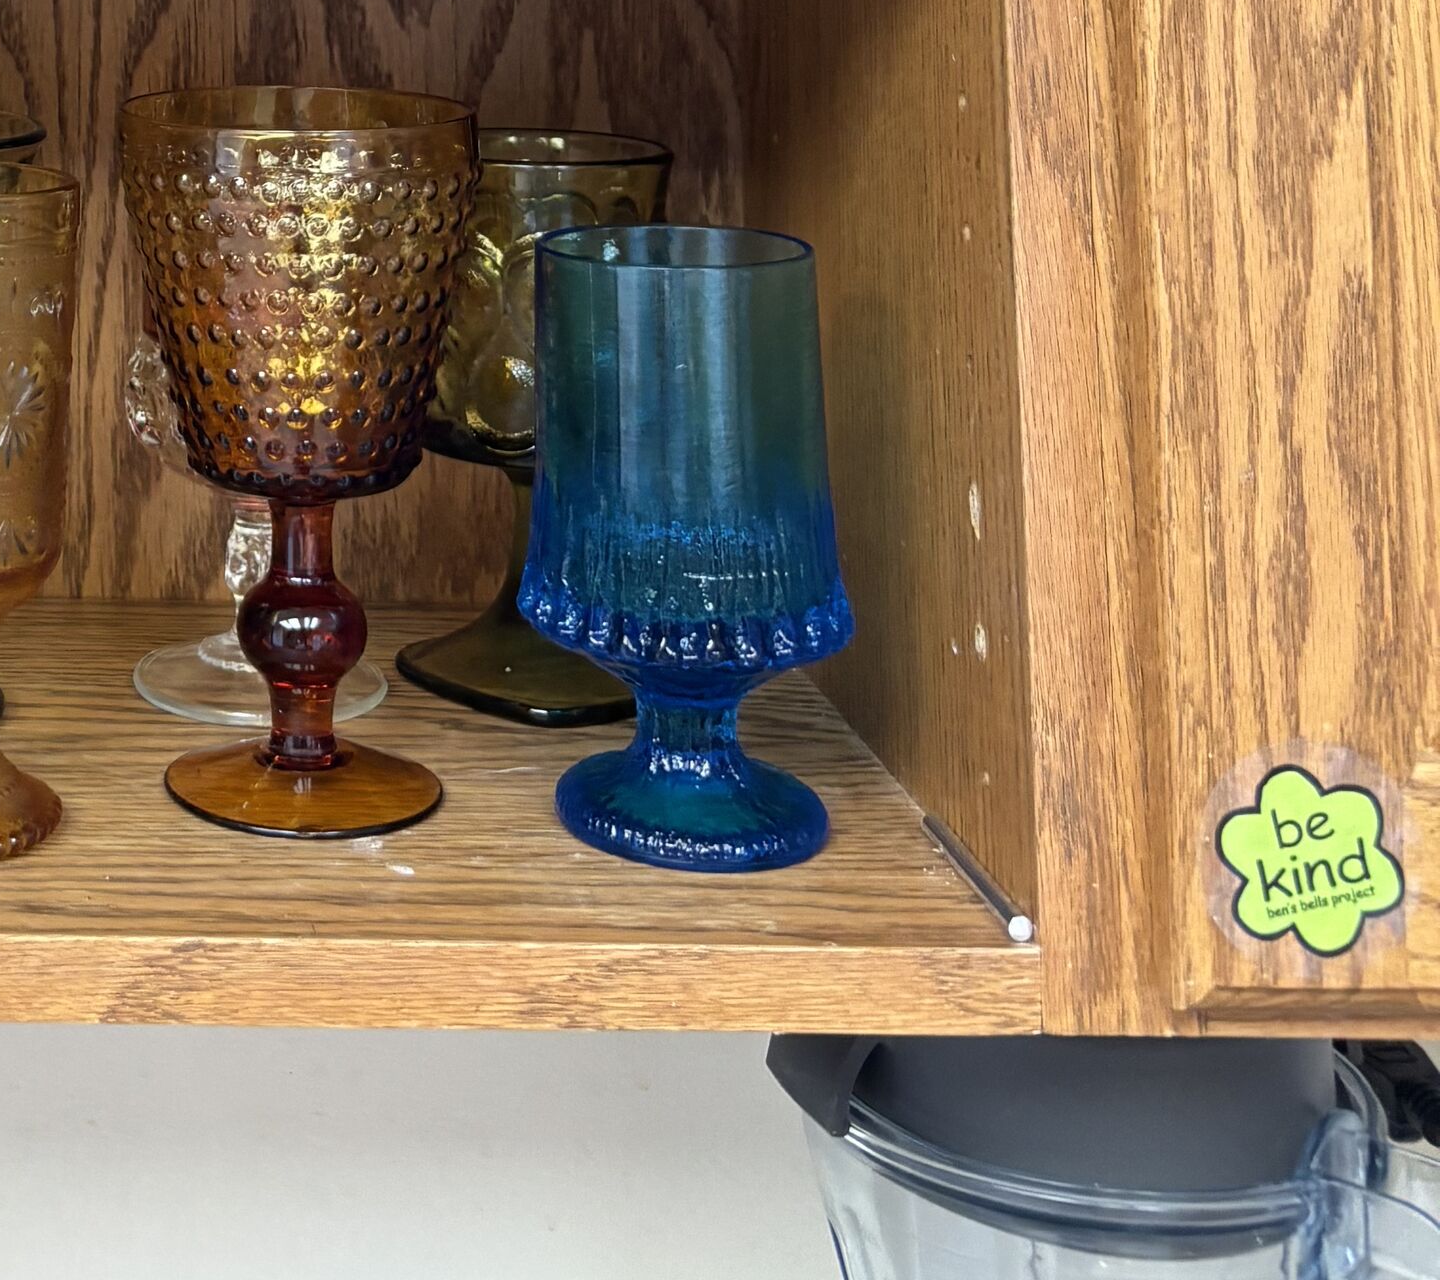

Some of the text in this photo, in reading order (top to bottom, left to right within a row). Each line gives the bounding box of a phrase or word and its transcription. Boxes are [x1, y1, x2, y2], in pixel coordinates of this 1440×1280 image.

[1271, 809, 1335, 848] be
[1257, 837, 1371, 902] kind
[1267, 886, 1375, 919] ben's bells project
